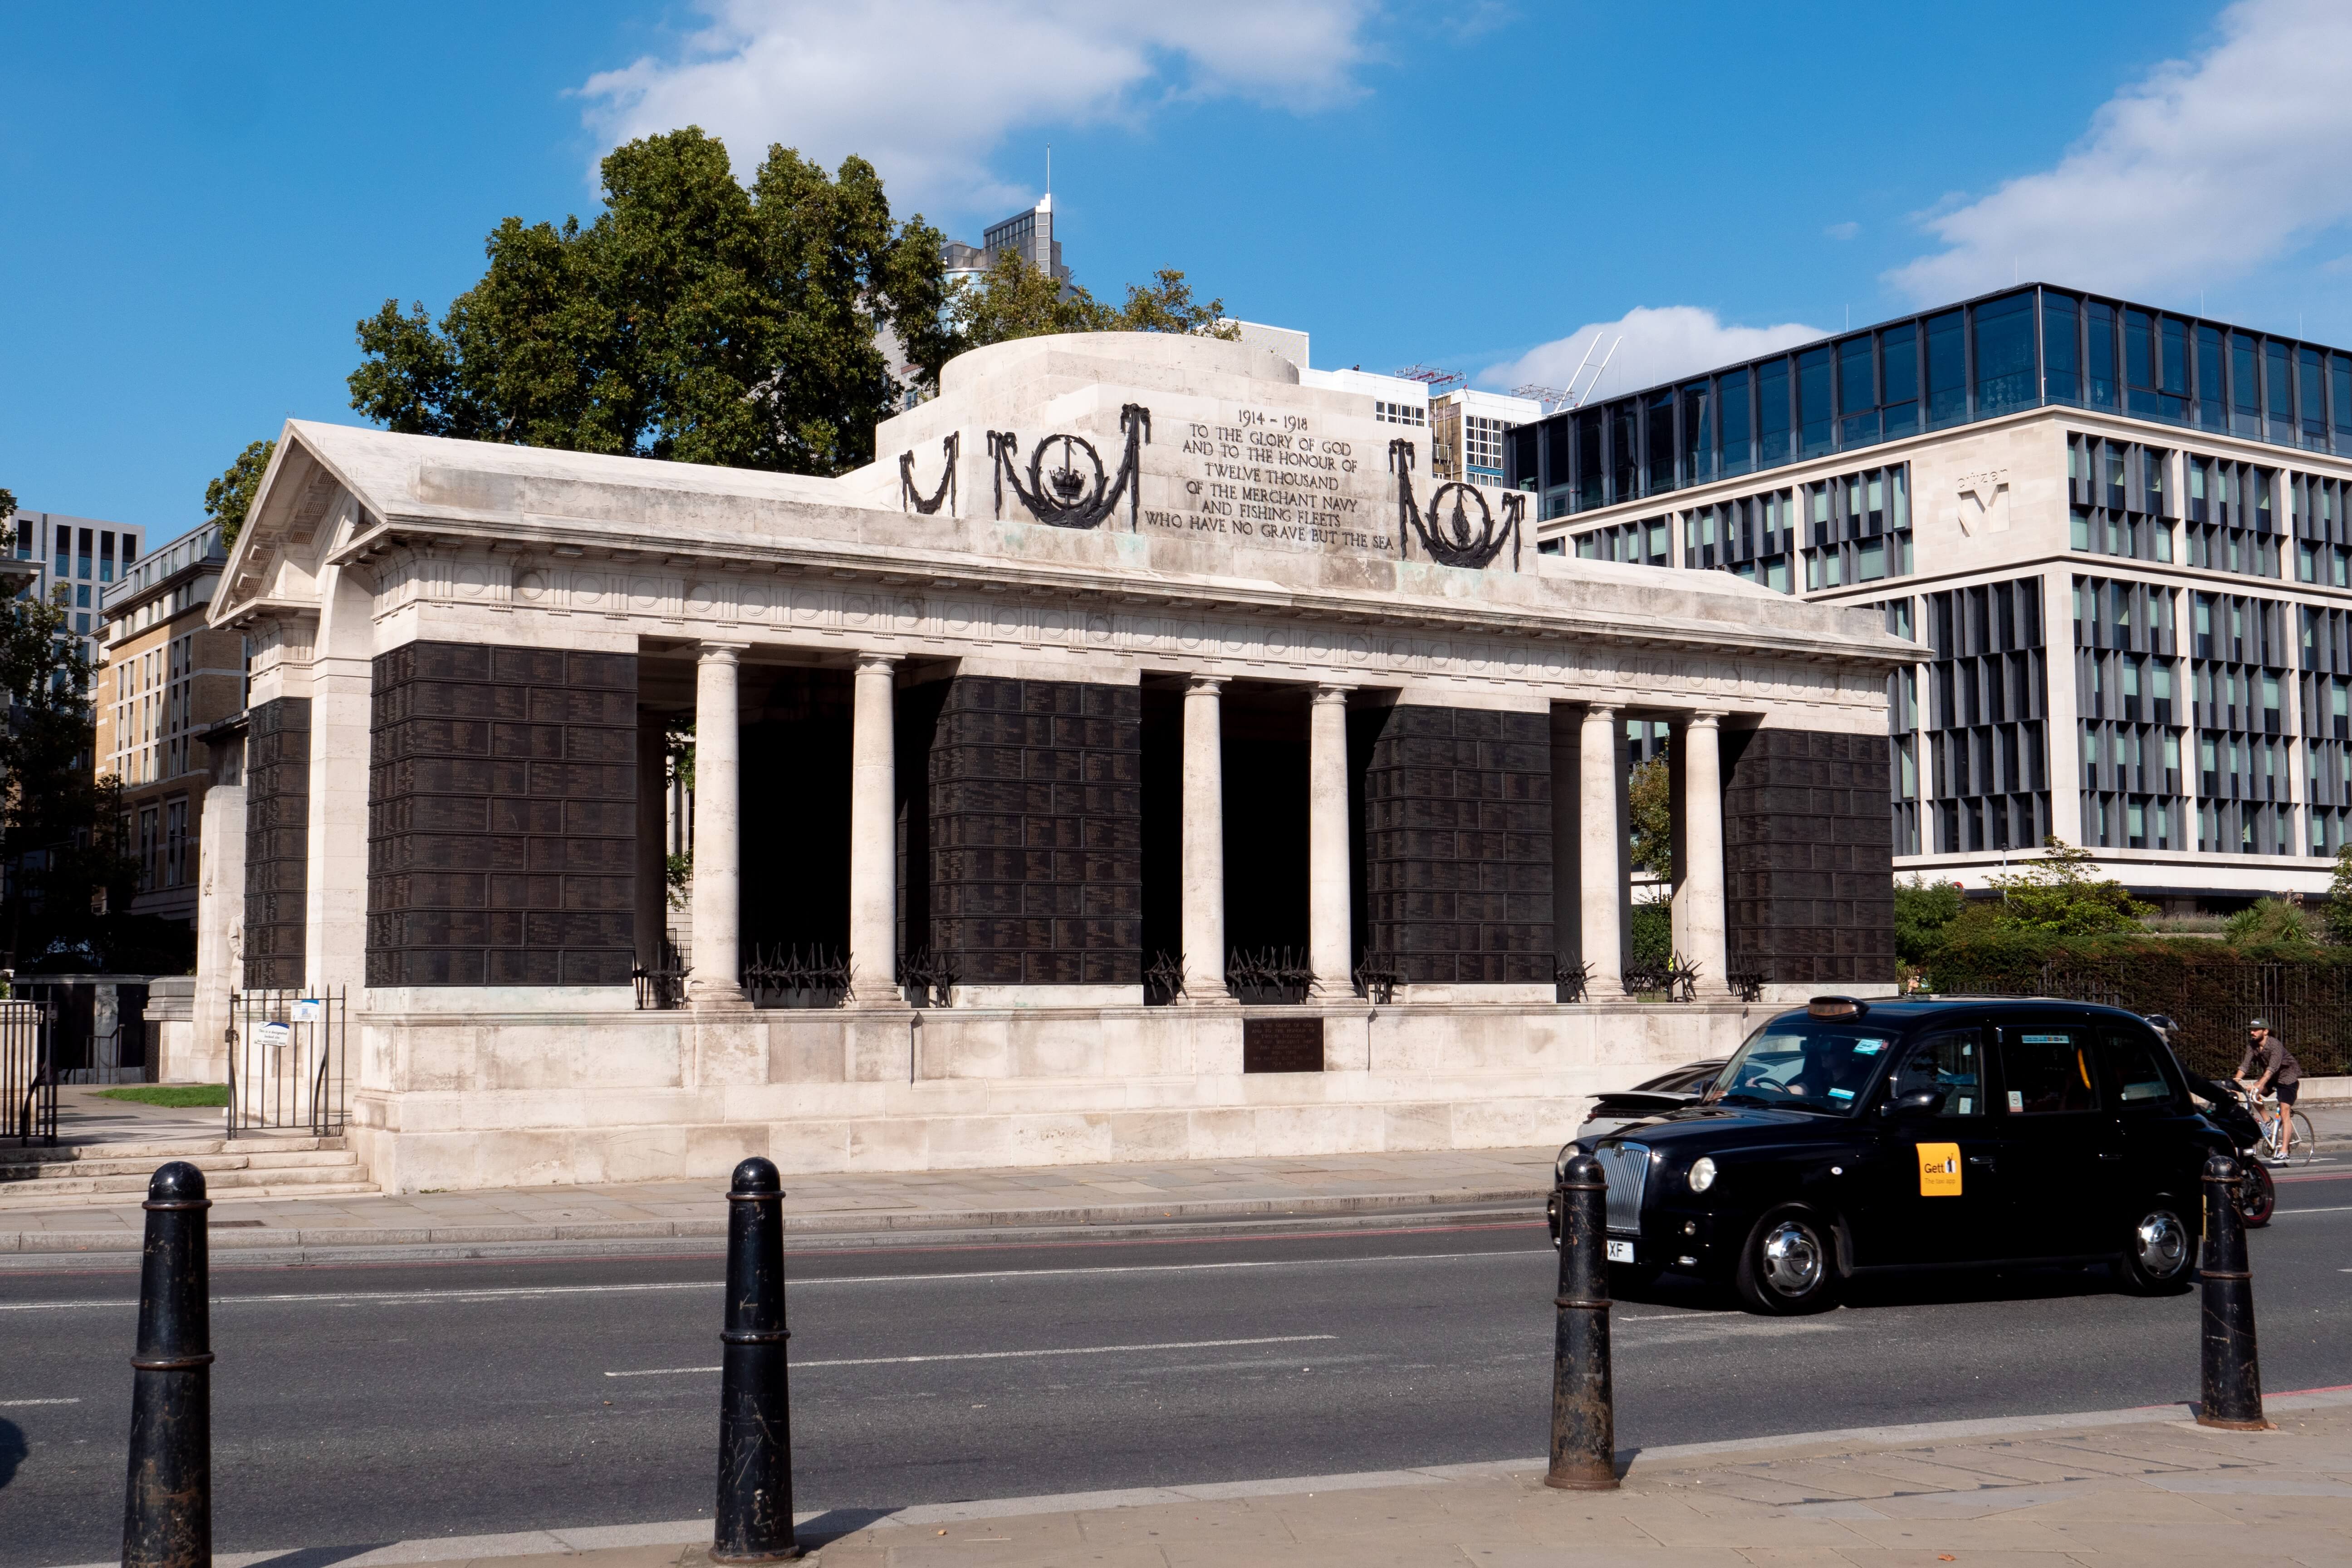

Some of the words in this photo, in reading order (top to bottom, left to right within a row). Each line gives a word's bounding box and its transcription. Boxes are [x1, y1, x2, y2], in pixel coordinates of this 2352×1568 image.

[1239, 409, 1265, 427] 1914
[1284, 415, 1308, 433] 1918
[1190, 423, 1208, 438] TO
[1215, 426, 1243, 443] THE
[1250, 431, 1293, 449] GLORY
[1299, 437, 1315, 452] OF
[1322, 441, 1352, 456] GOD
[1183, 440, 1214, 456] AND
[1220, 442, 1240, 459] TO
[1247, 446, 1274, 464] THE
[1279, 451, 1337, 470] HONOUR
[1342, 459, 1358, 473] OF
[1205, 462, 1261, 482] TWELVE
[1265, 469, 1338, 490] THOUSAND
[1957, 469, 2008, 489] citizen
[1186, 480, 1204, 495] OF
[1210, 483, 1237, 500] THE
[1243, 486, 1318, 509] MERCHANT
[1323, 496, 1358, 513] NAVY
[1202, 500, 1232, 516] AND
[1240, 503, 1292, 522] FISHING
[1298, 510, 1341, 528] FLEETS
[1145, 510, 1182, 529] WHO
[1190, 515, 1227, 533] HAVE
[1233, 520, 1253, 535] NO
[1261, 523, 1306, 541] GRAVE
[1311, 529, 1338, 544] BUT
[1342, 531, 1368, 548] THE
[1373, 535, 1394, 550] SEA
[1924, 1163, 1945, 1174] Gett
